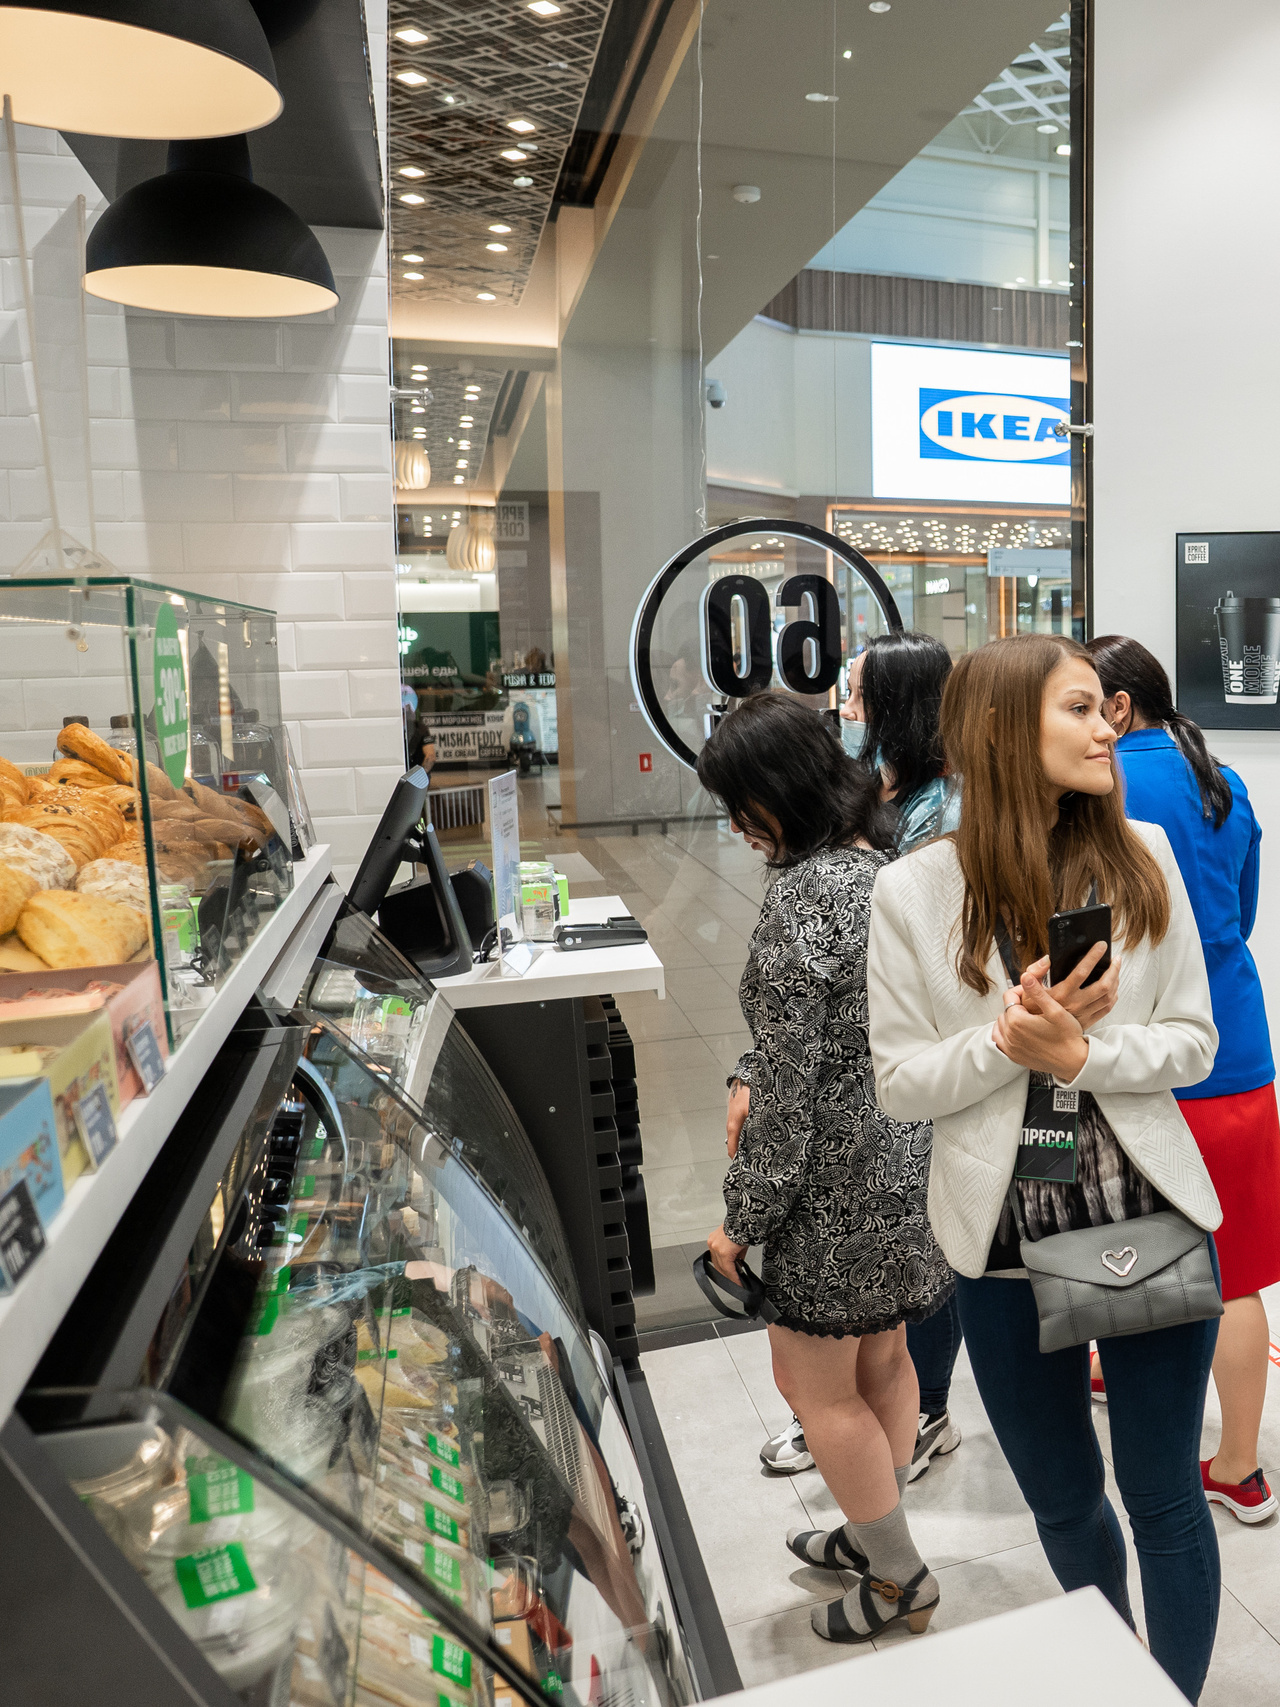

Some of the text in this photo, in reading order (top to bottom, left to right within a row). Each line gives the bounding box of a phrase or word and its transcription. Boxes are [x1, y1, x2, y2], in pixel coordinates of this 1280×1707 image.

[938, 410, 1069, 444] IKEA
[1188, 554, 1207, 562] COFFEE
[1190, 545, 1207, 553] PRICE
[1229, 660, 1244, 693] ONE
[1243, 645, 1261, 694] MORE
[1260, 654, 1275, 694] TIME
[1055, 1100, 1077, 1110] COFFEE
[1060, 1090, 1077, 1101] PRICE
[1019, 1127, 1074, 1149] ПРЕССА
